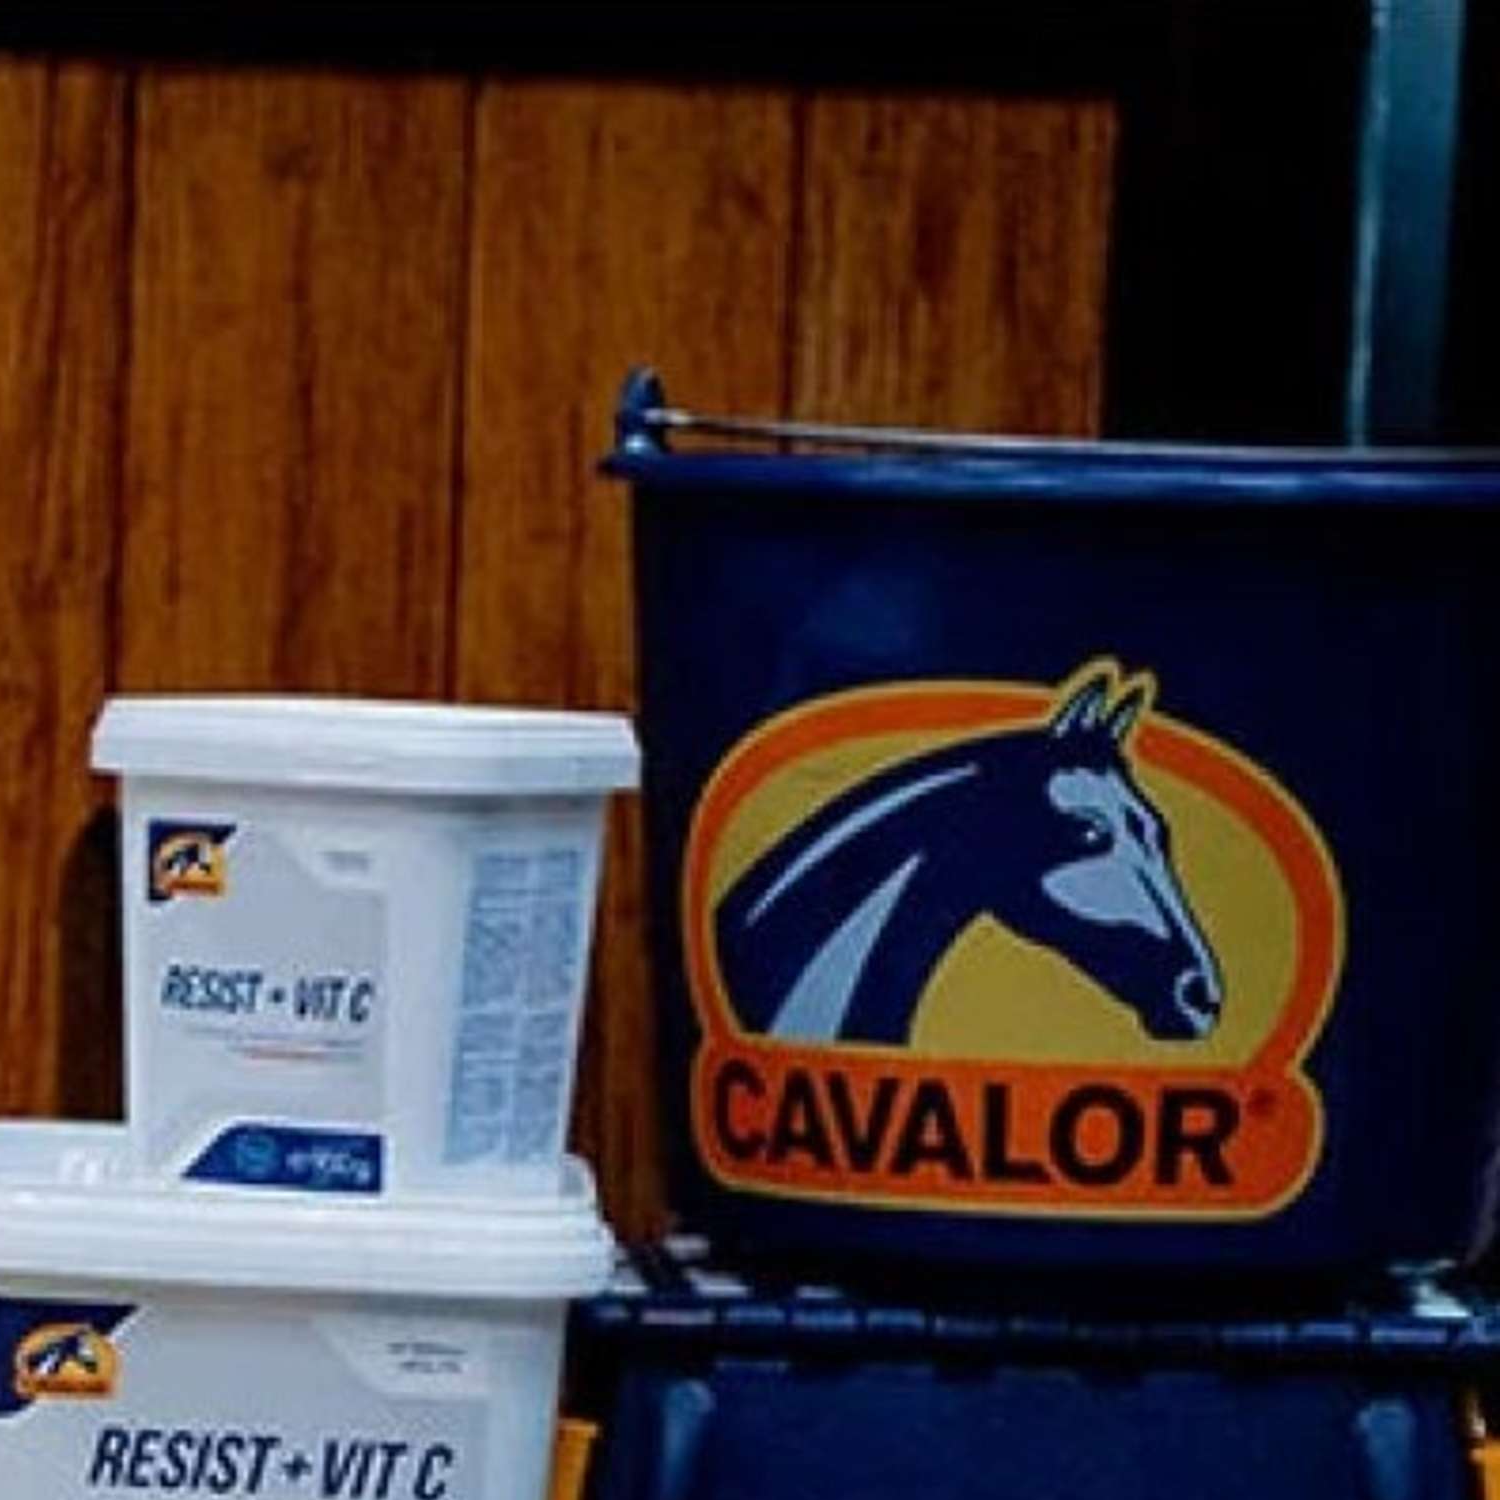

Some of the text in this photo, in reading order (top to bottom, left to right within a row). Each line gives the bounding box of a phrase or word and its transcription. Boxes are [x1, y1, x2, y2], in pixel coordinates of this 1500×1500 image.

[160, 964, 263, 1014] RESIST
[712, 1057, 1241, 1188] CAVALOR
[89, 1428, 278, 1495] RESIST
[321, 1440, 408, 1500] VIT
